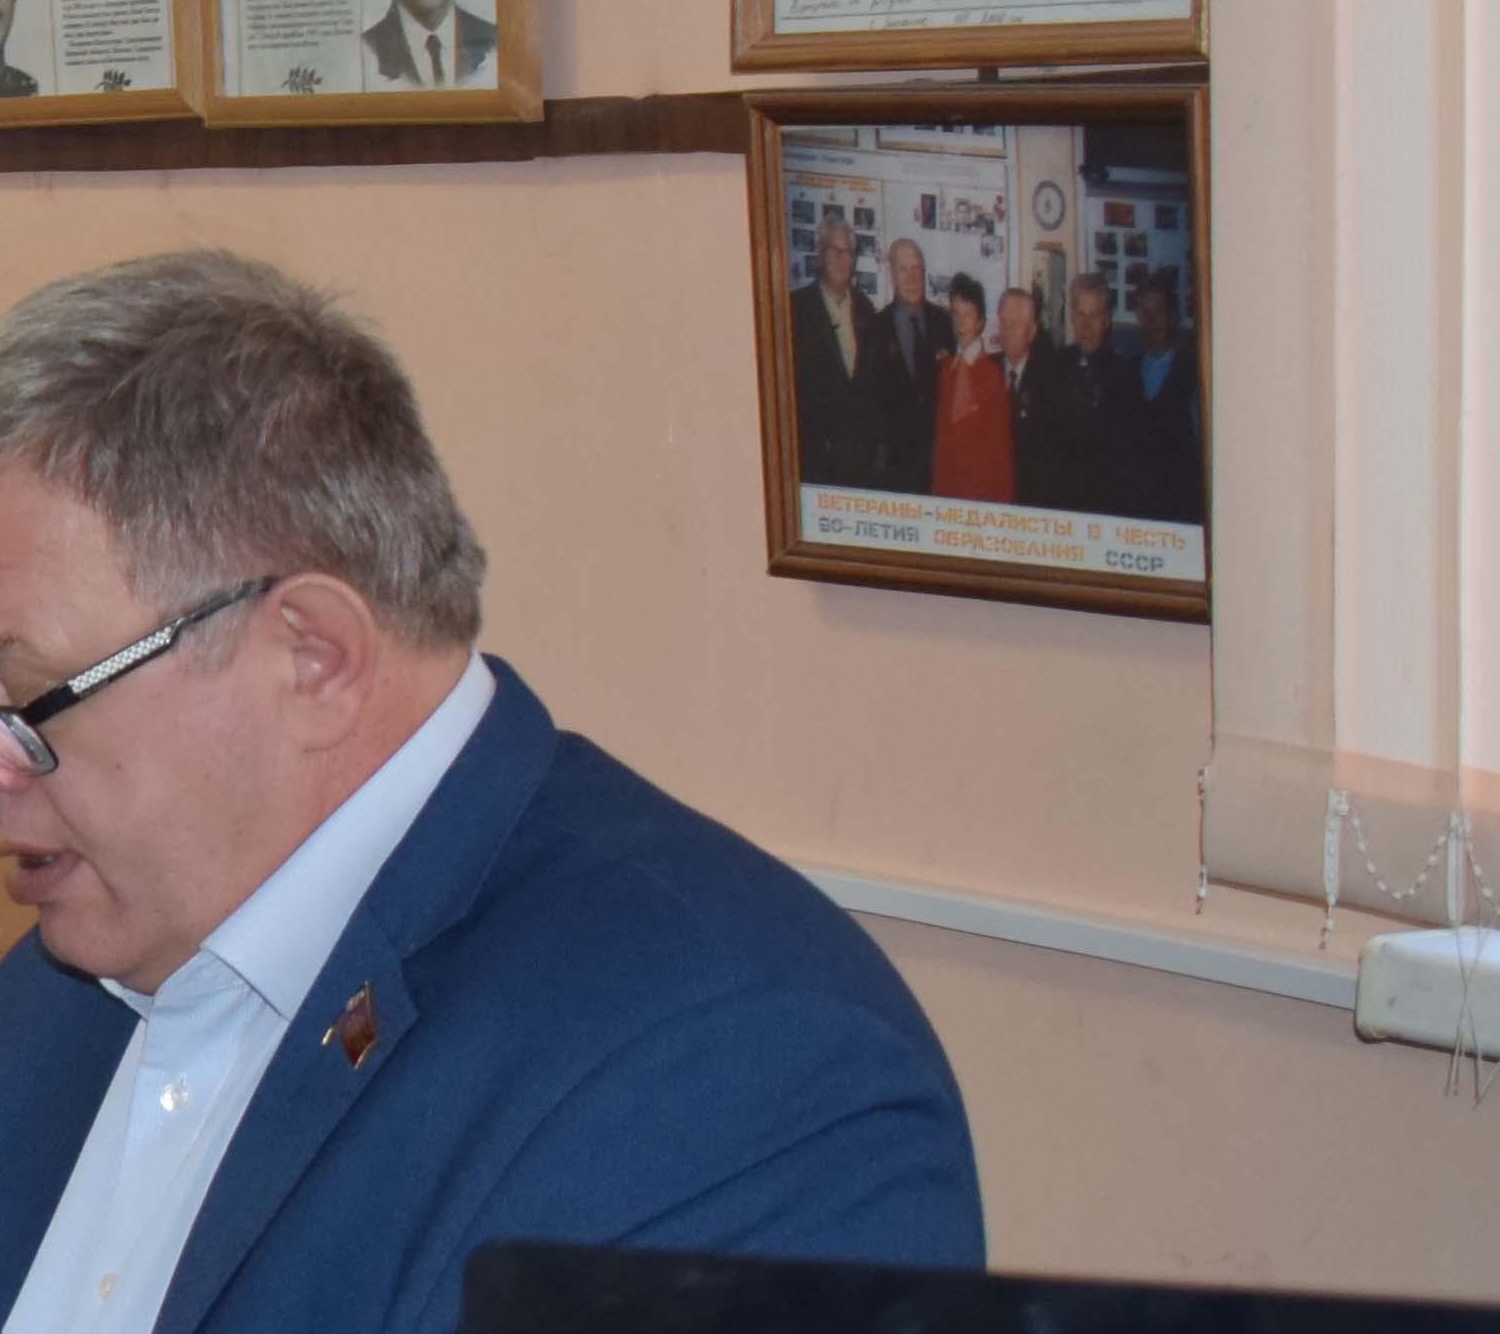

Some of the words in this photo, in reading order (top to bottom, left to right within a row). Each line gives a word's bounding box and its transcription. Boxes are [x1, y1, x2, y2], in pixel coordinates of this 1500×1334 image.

[817, 492, 1074, 537] ВЕТЕРАНЫ-МЕДАЛИСТЫ
[1114, 524, 1188, 551] ЧЕСТЬ
[933, 528, 1084, 563] ОБРАЗОВАНИЯ
[1104, 550, 1165, 573] СССР
